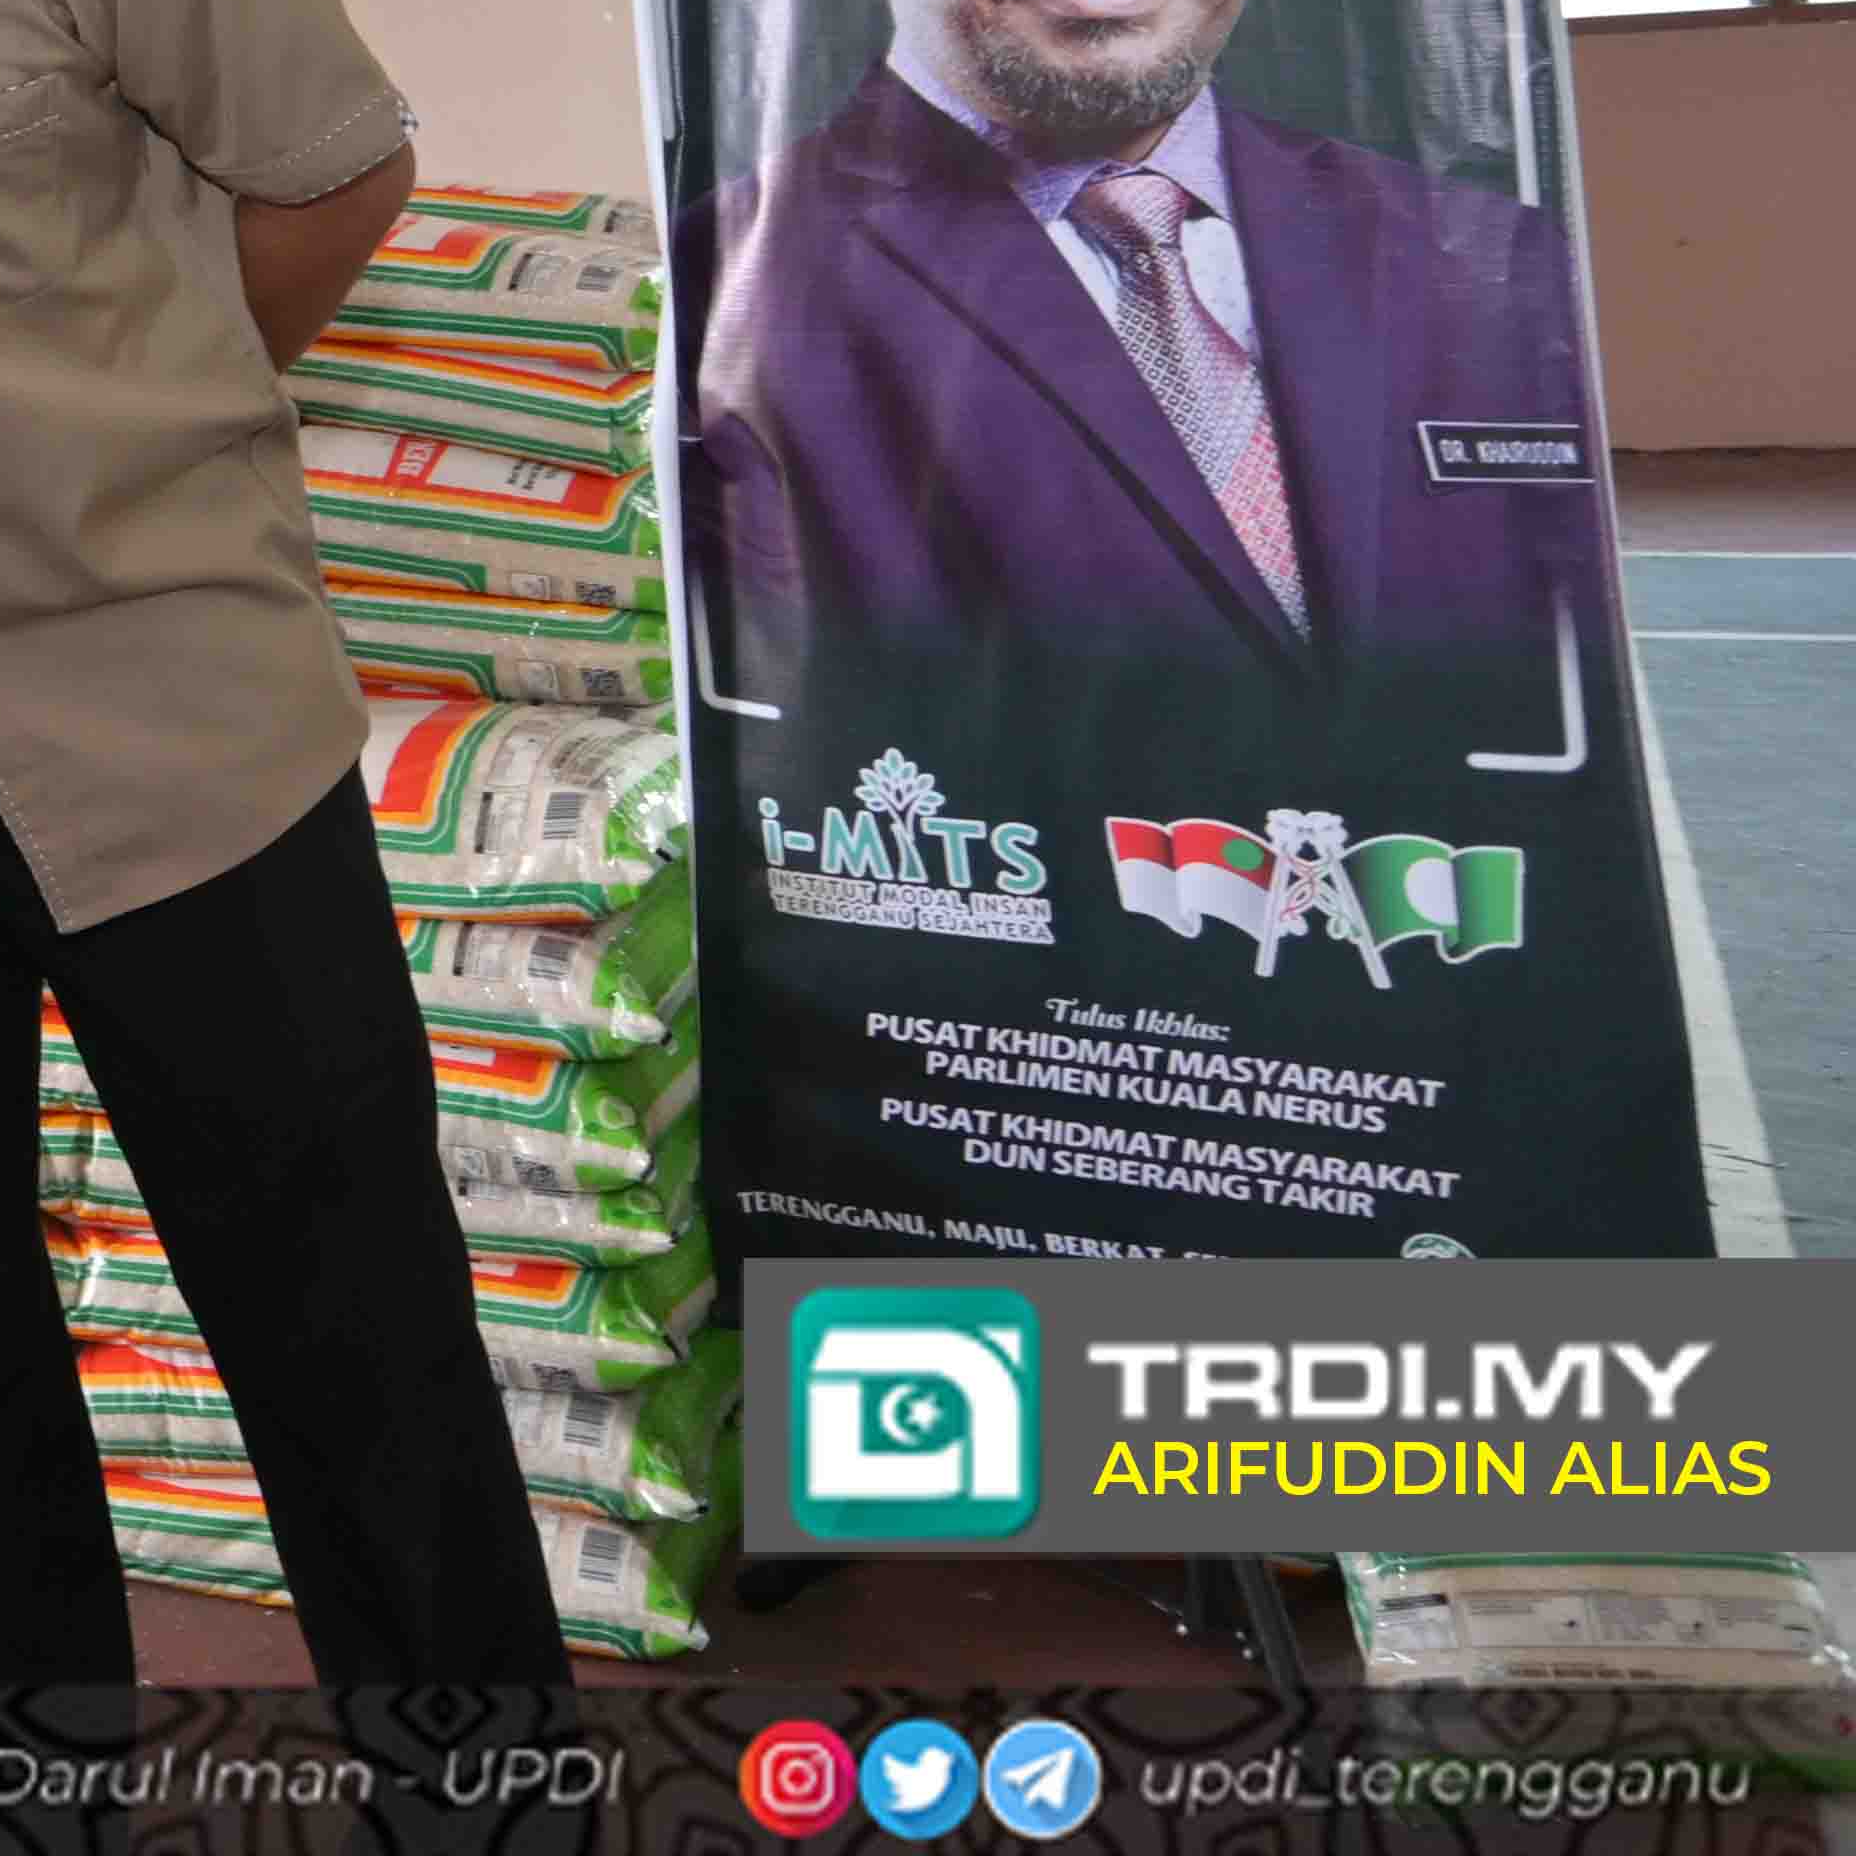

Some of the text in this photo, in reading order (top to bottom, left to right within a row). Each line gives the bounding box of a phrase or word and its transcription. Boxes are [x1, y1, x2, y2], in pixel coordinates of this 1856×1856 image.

[769, 869, 1051, 920] INSTITUT MODAL INSAN
[774, 896, 1054, 943] TERENGGANU SEJAHTERA
[1045, 997, 1127, 1031] Tulus
[867, 1012, 1446, 1108] PUSAT KHIDMAT MASYARAKAT
[925, 1051, 1388, 1134] PARLIMEN KUALA NERUS
[881, 1097, 1460, 1200] PUSAT KHIDMAT MASYARAKAT
[963, 1139, 1376, 1219] DUN SEBERANG TAKIR
[737, 1190, 935, 1239] TERENGGANU,
[944, 1218, 1036, 1251] MAJU,
